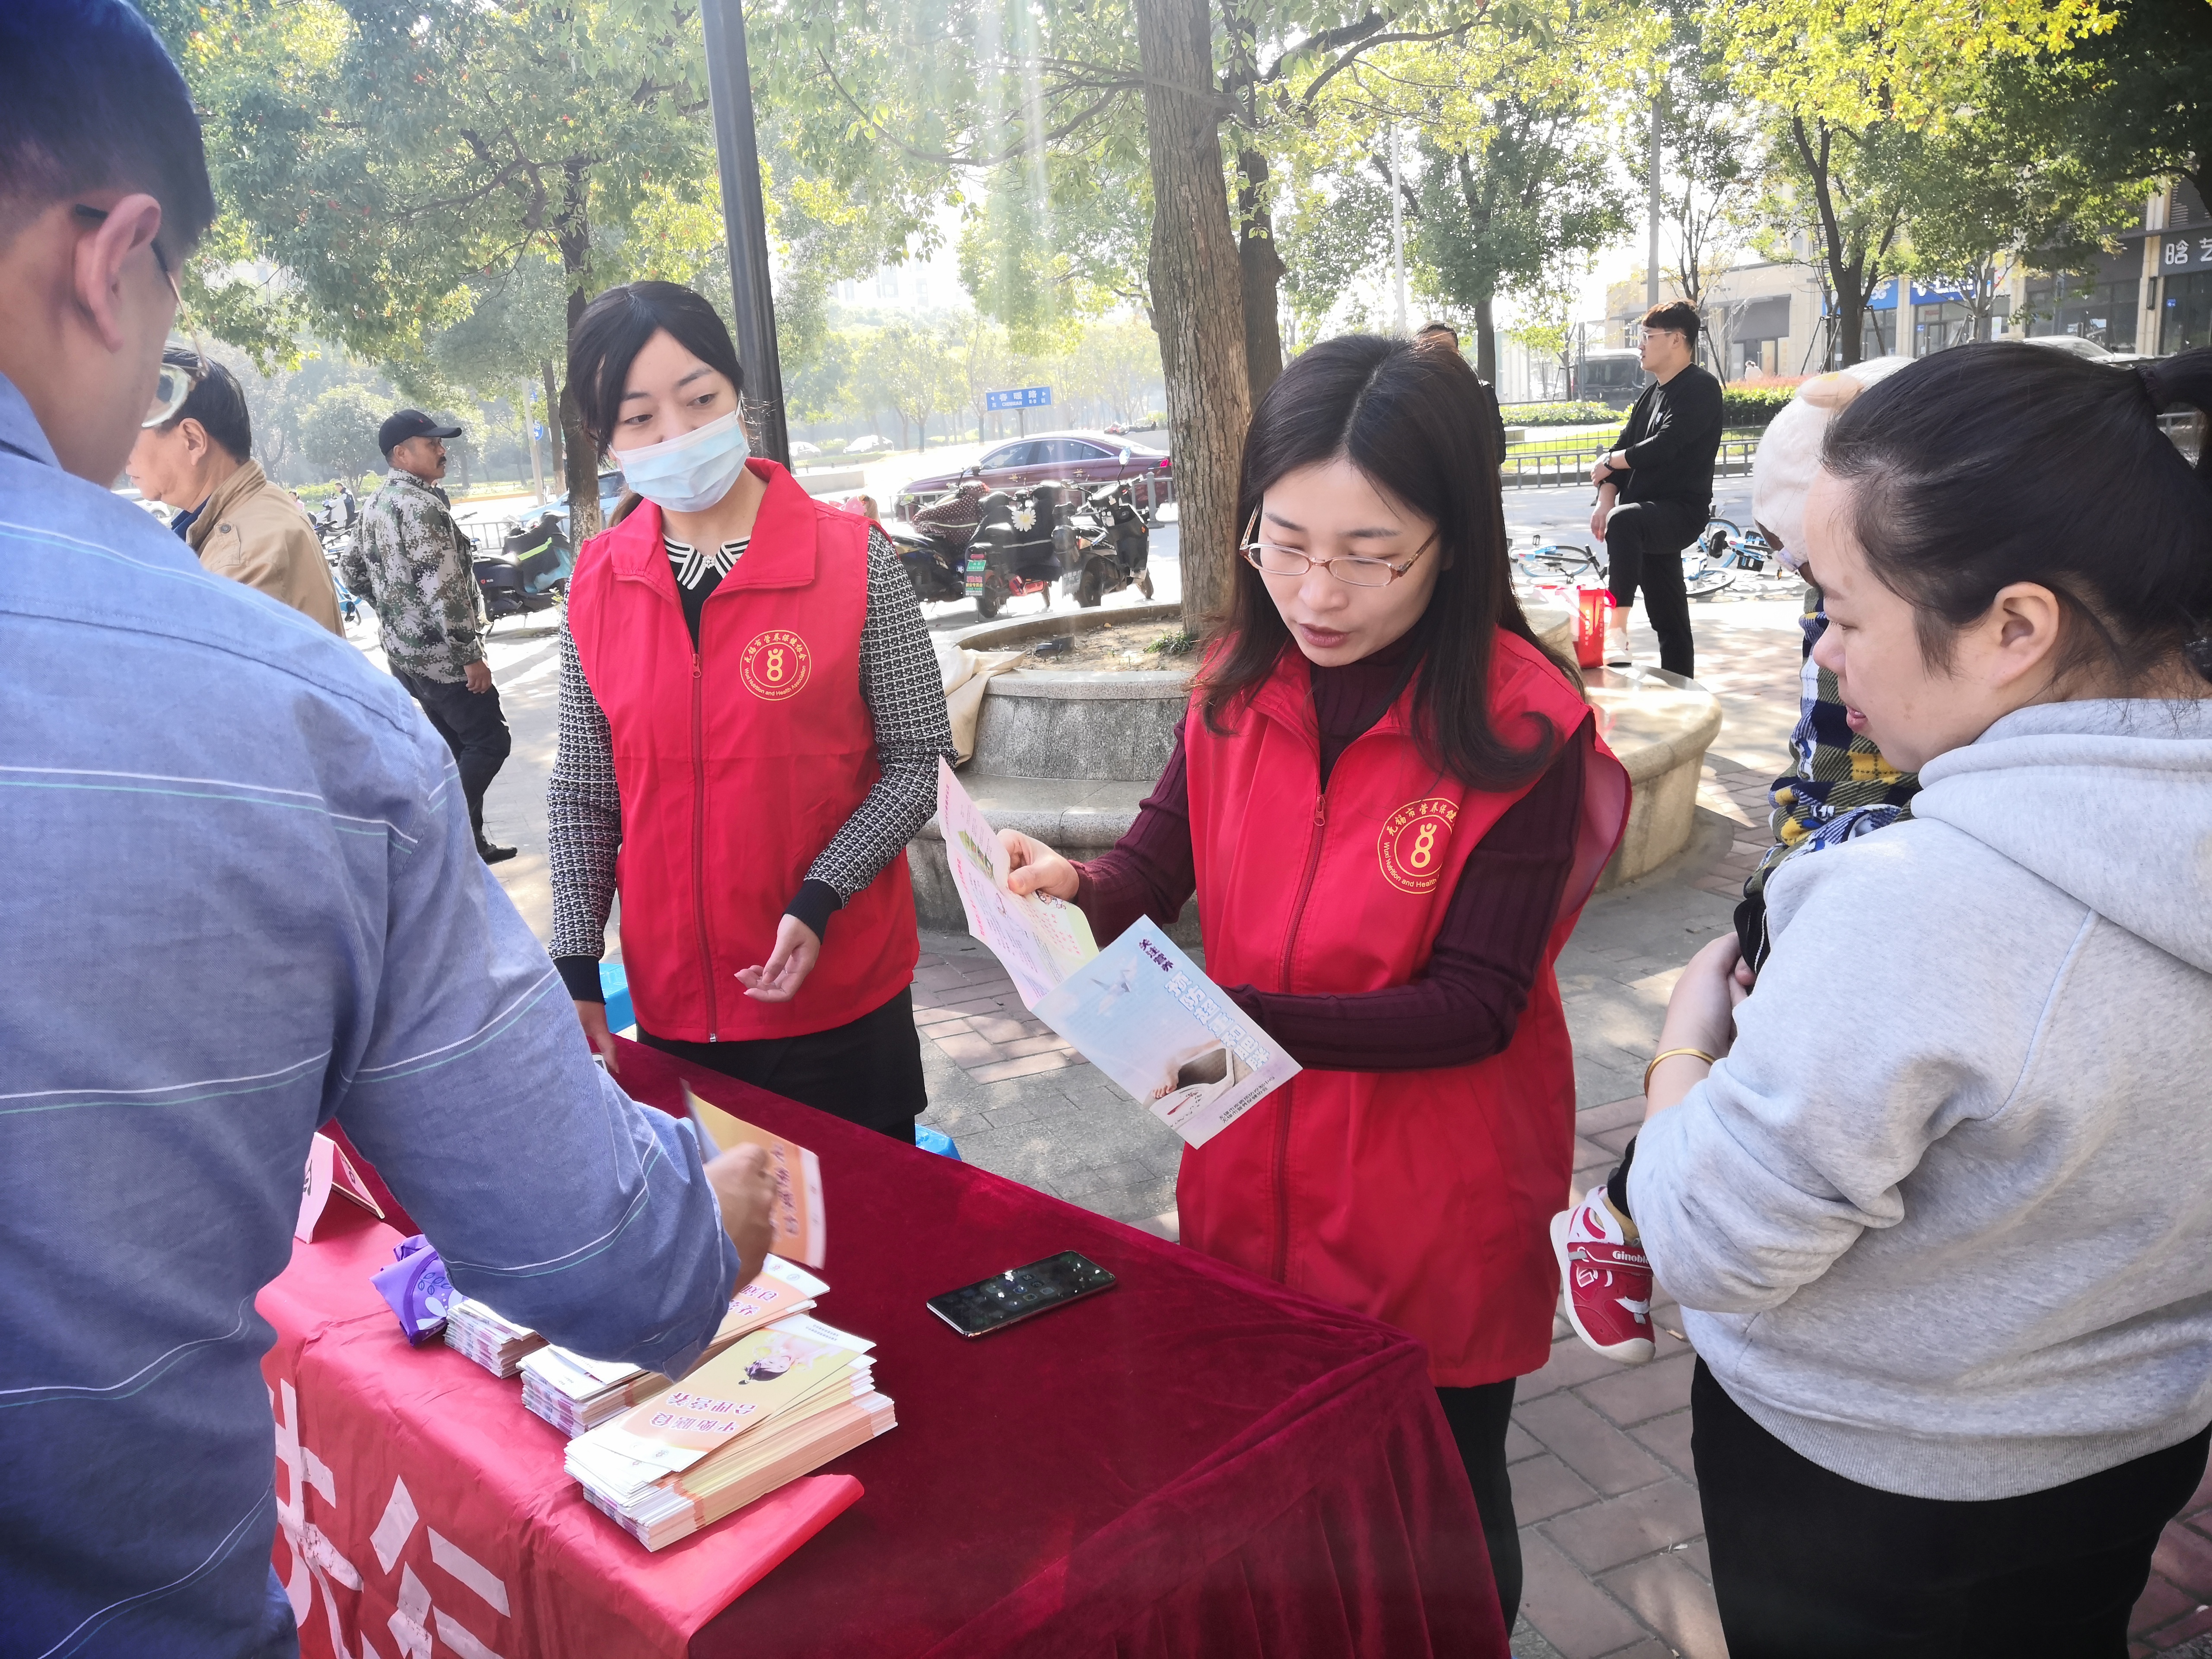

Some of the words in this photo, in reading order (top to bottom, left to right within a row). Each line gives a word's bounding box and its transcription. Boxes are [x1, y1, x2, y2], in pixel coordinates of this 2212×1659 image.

[744, 632, 807, 663] 无锡市营养保健协会
[749, 680, 764, 694] Nutrition
[776, 687, 791, 696] Health
[791, 665, 806, 689] Association
[1386, 801, 1457, 837] 无锡市营养保健
[1386, 858, 1401, 882] Nutrition
[1401, 879, 1414, 887] and
[1416, 878, 1437, 888] Health
[1138, 938, 1174, 973] 关注营养
[1164, 970, 1271, 1071] 预防超重和肥胖
[666, 1391, 757, 1415] 合理营养
[649, 1412, 740, 1433] 平衡膳食
